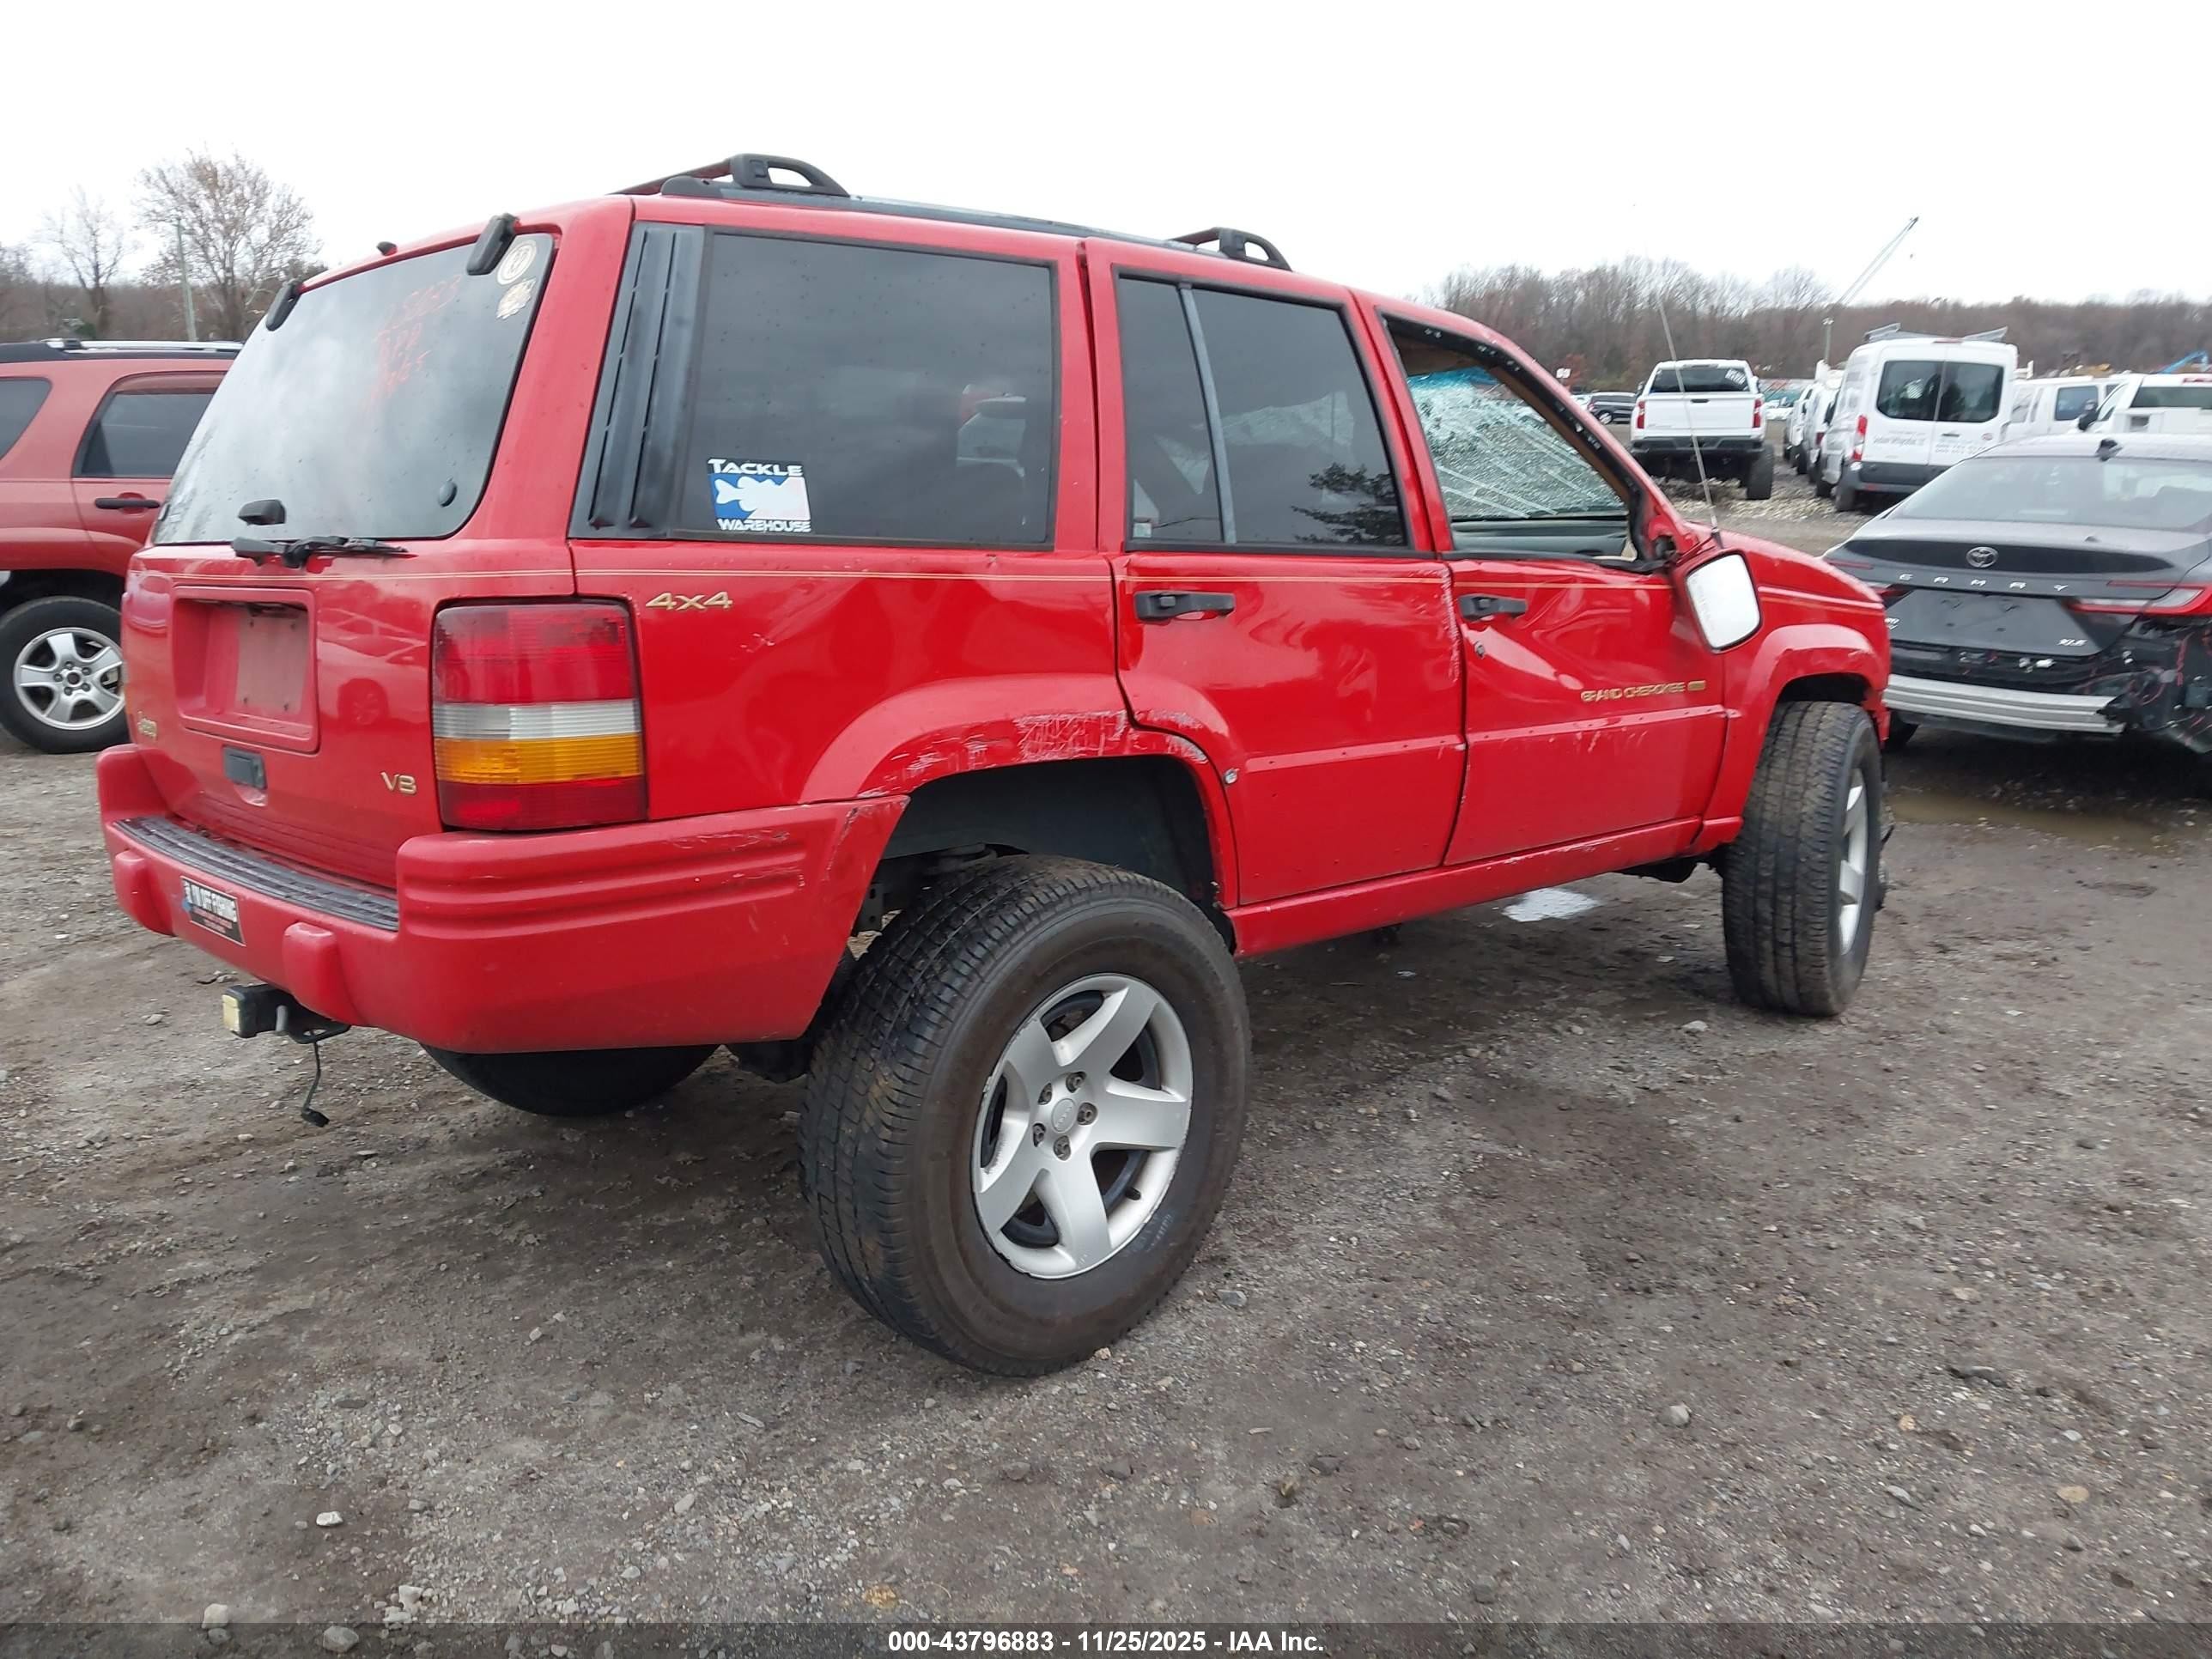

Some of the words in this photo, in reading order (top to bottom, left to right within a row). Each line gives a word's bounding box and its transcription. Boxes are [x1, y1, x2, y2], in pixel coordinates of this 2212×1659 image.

[708, 459, 804, 477] TACKLE
[716, 518, 811, 532] WAREHOUSE
[1899, 573, 2069, 592] CAMRY
[380, 771, 416, 795] V8
